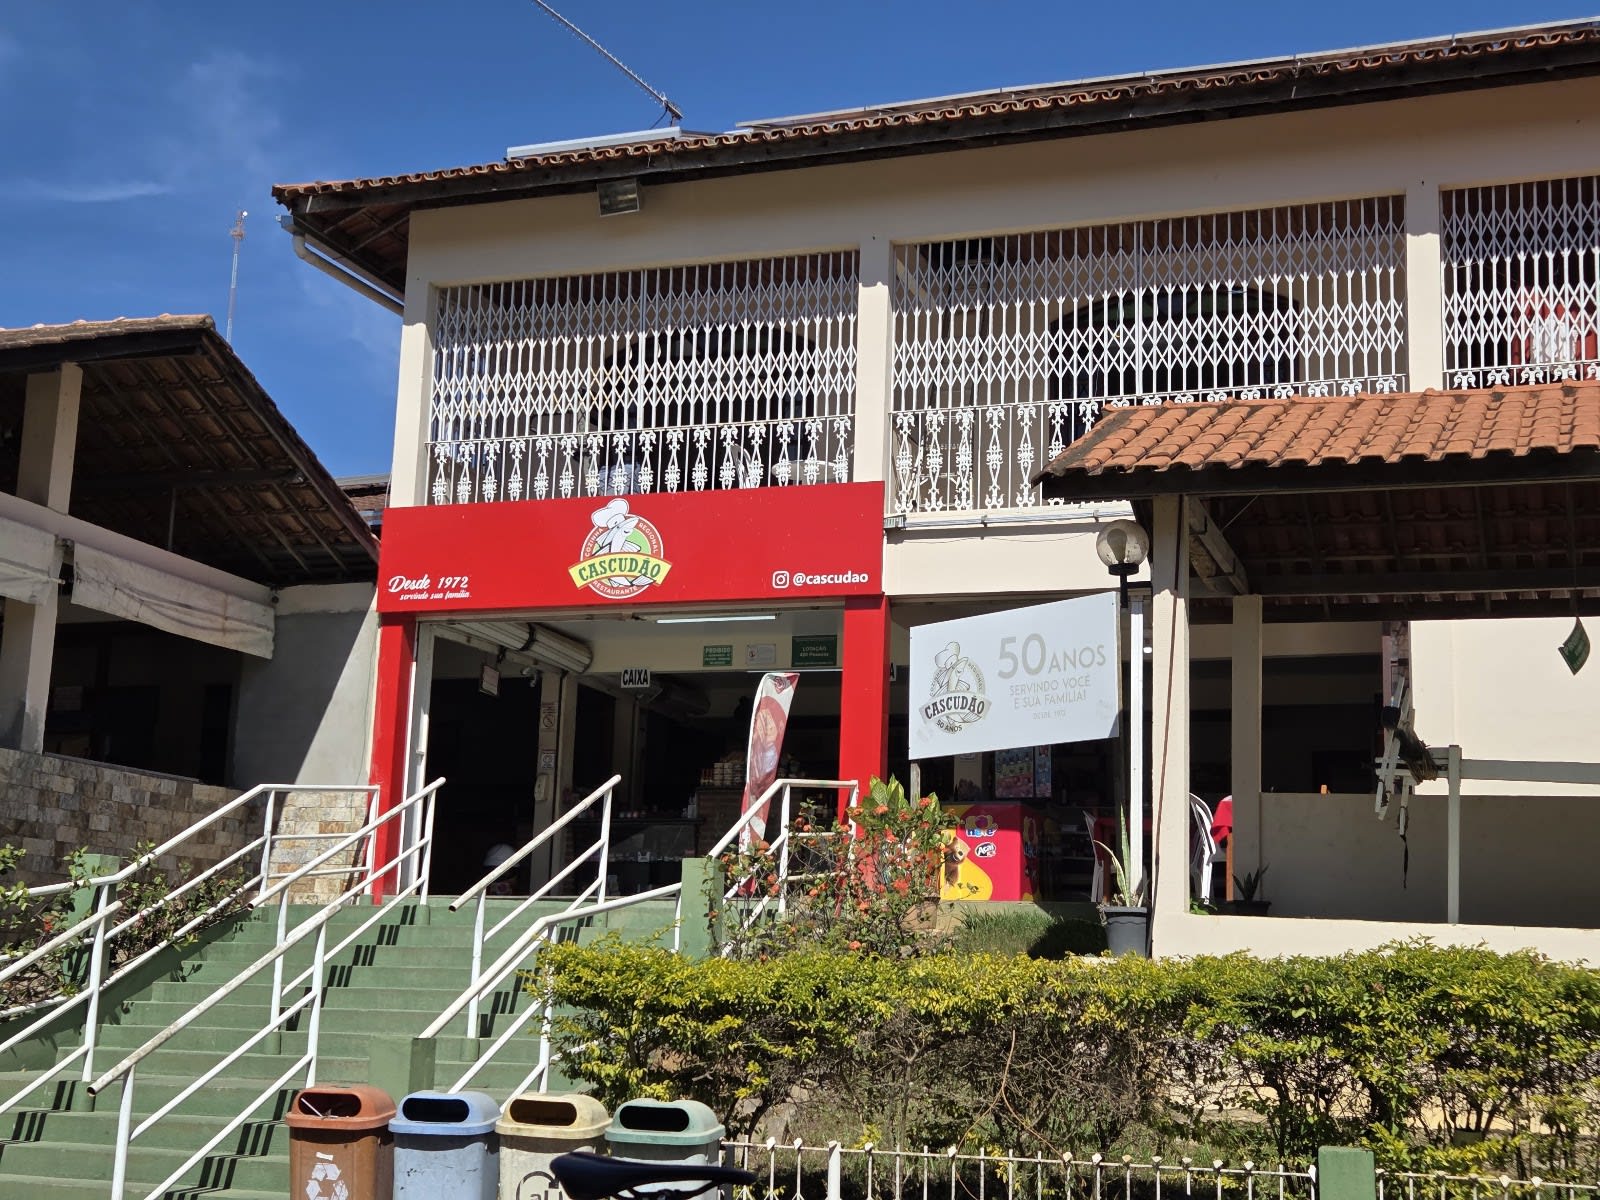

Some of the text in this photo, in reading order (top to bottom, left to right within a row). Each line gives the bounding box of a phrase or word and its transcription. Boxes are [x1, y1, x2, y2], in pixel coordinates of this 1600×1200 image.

[585, 528, 604, 557] COZINHA
[638, 522, 659, 554] REGIONAL
[578, 557, 661, 582] CASCUDÃO
[793, 571, 869, 586] @cascudao
[388, 574, 469, 593] Desde 1972
[592, 580, 638, 595] RESTAURANTE
[400, 592, 429, 601] servindo
[998, 633, 1107, 679] 50 ANOS
[623, 669, 648, 685] CAIXA
[1009, 674, 1091, 696] SERVINDO VOCÊ
[924, 695, 985, 719] CASCUDÃO
[1014, 698, 1021, 709] E
[1023, 696, 1041, 708] SUA
[936, 719, 963, 733] 50 ANOS
